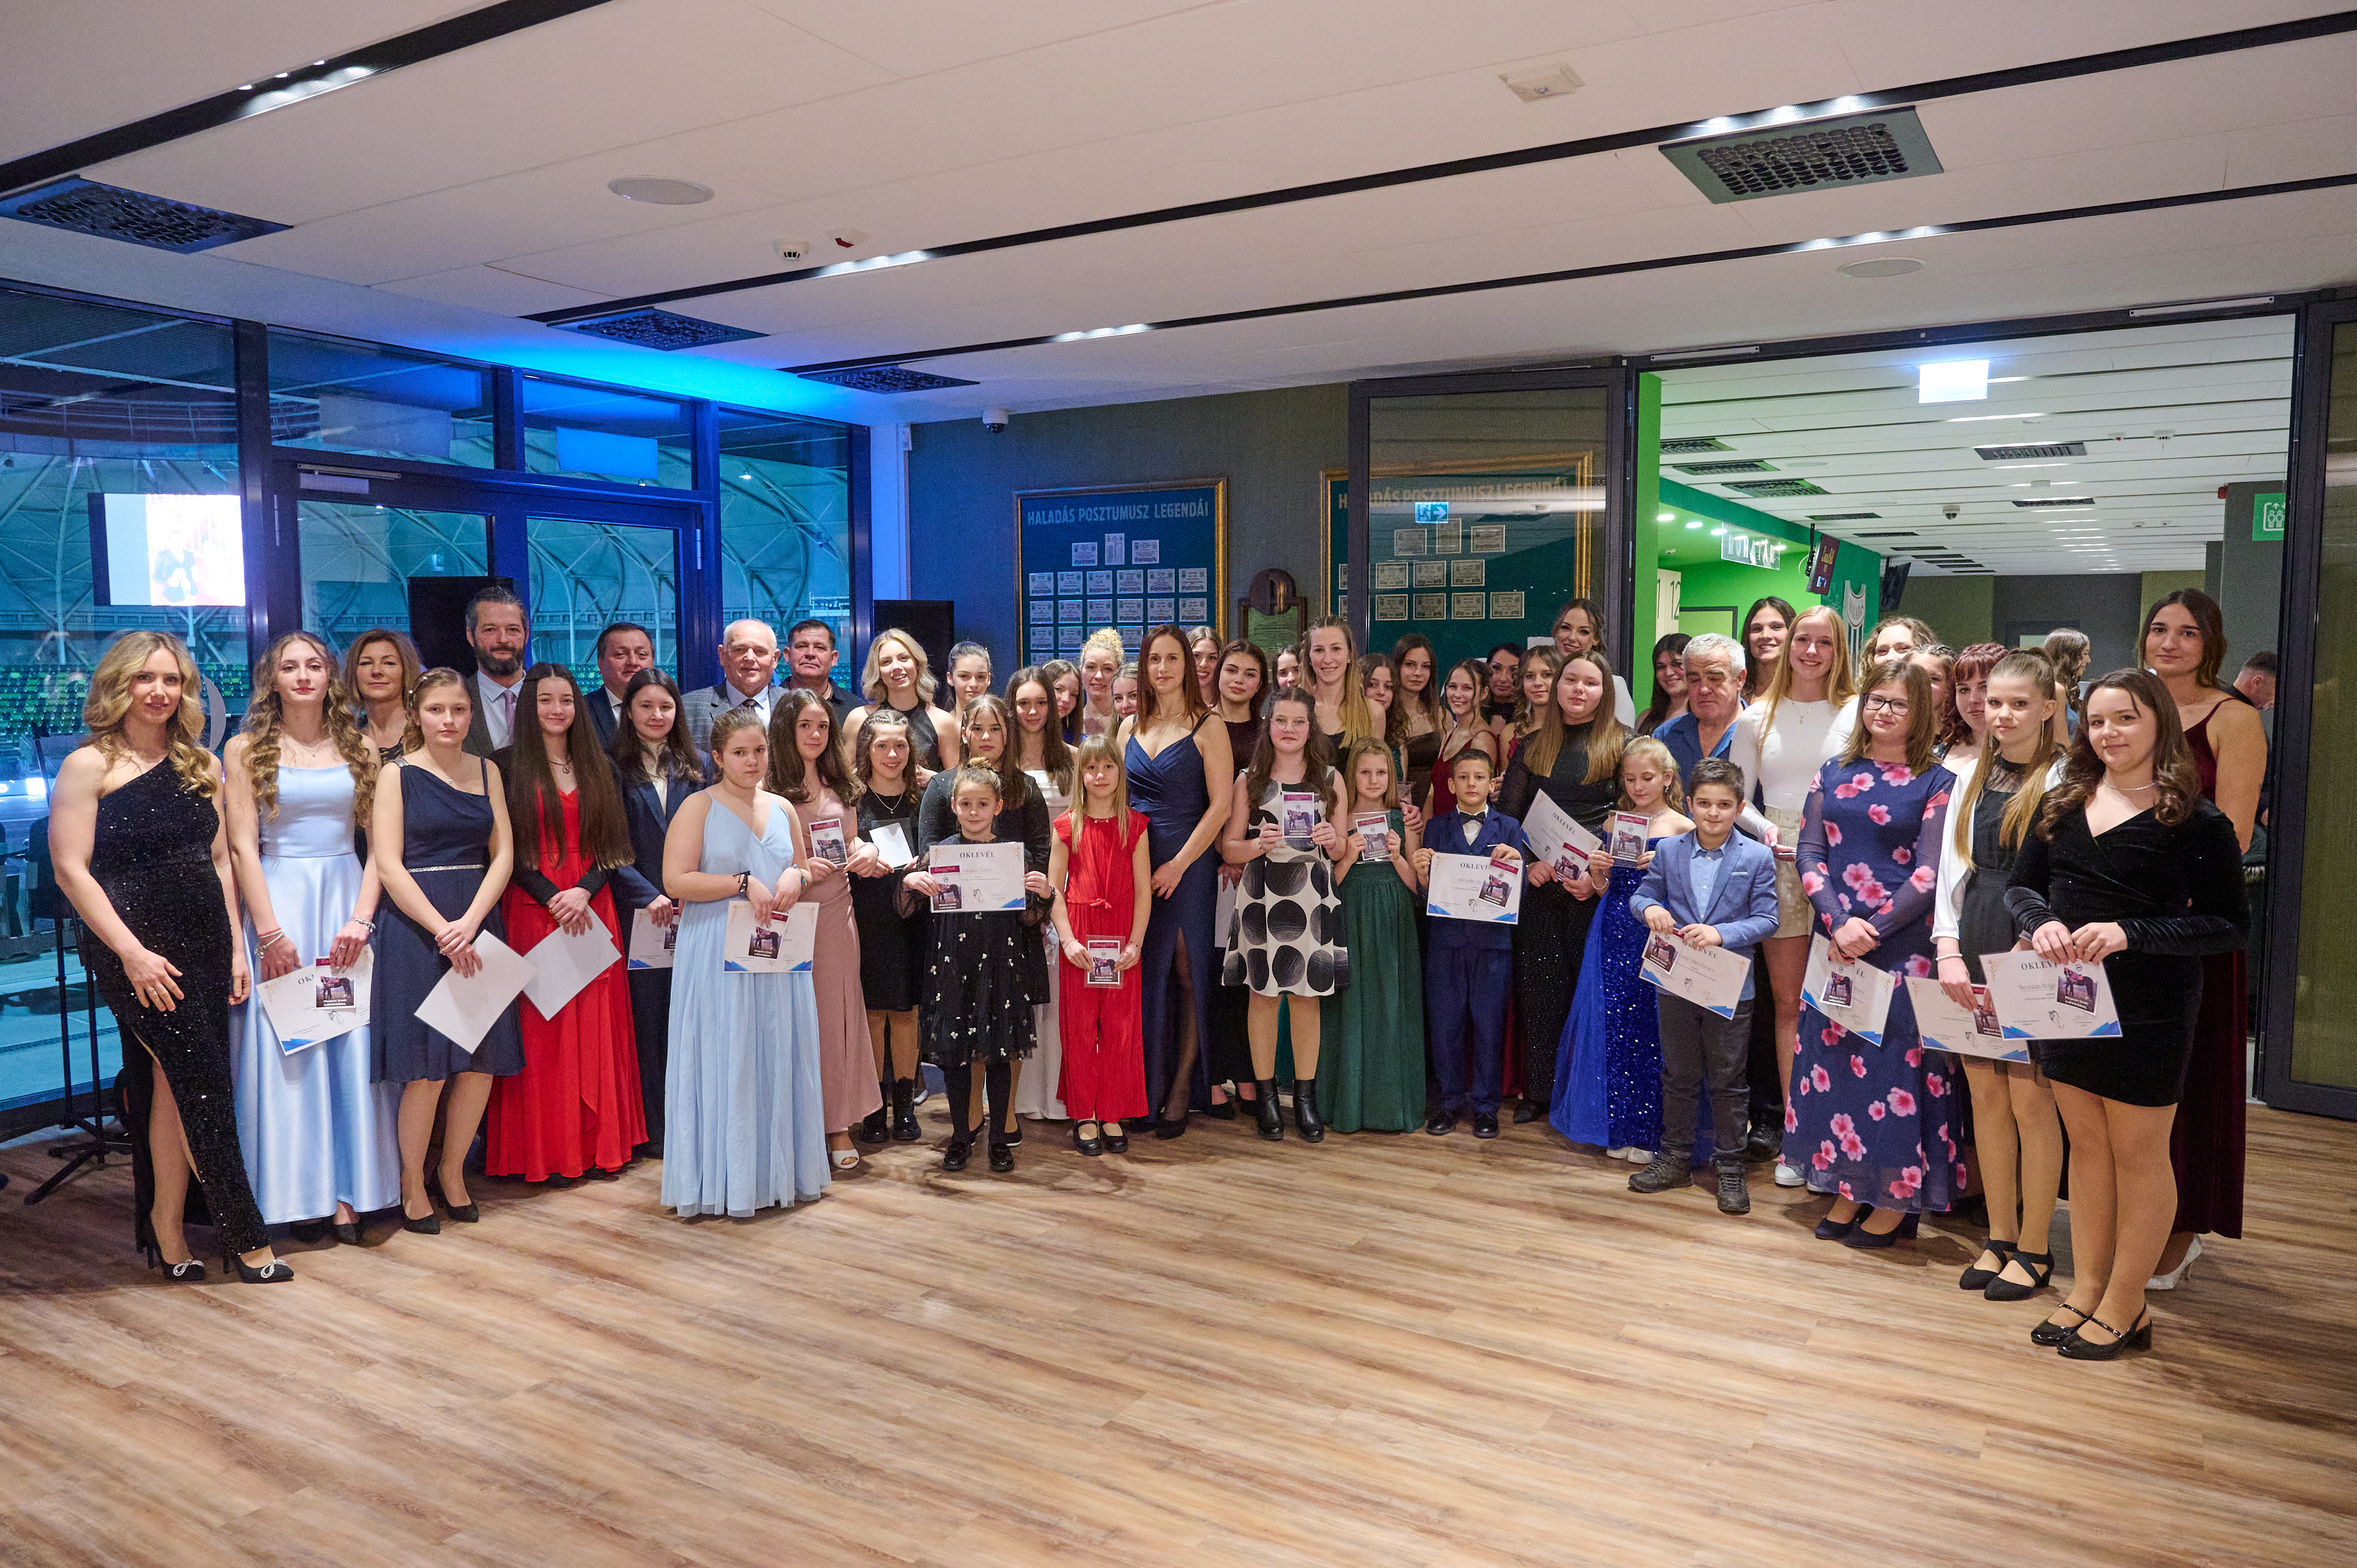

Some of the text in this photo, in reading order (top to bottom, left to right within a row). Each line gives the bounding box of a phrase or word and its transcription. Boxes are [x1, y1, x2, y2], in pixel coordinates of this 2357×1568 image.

[1028, 498, 1208, 526] HALADÁS POSZTUMUSZ LEGENDÁI
[1553, 813, 1575, 836] OKLEVÉL
[2021, 961, 2057, 970] OKLEV
